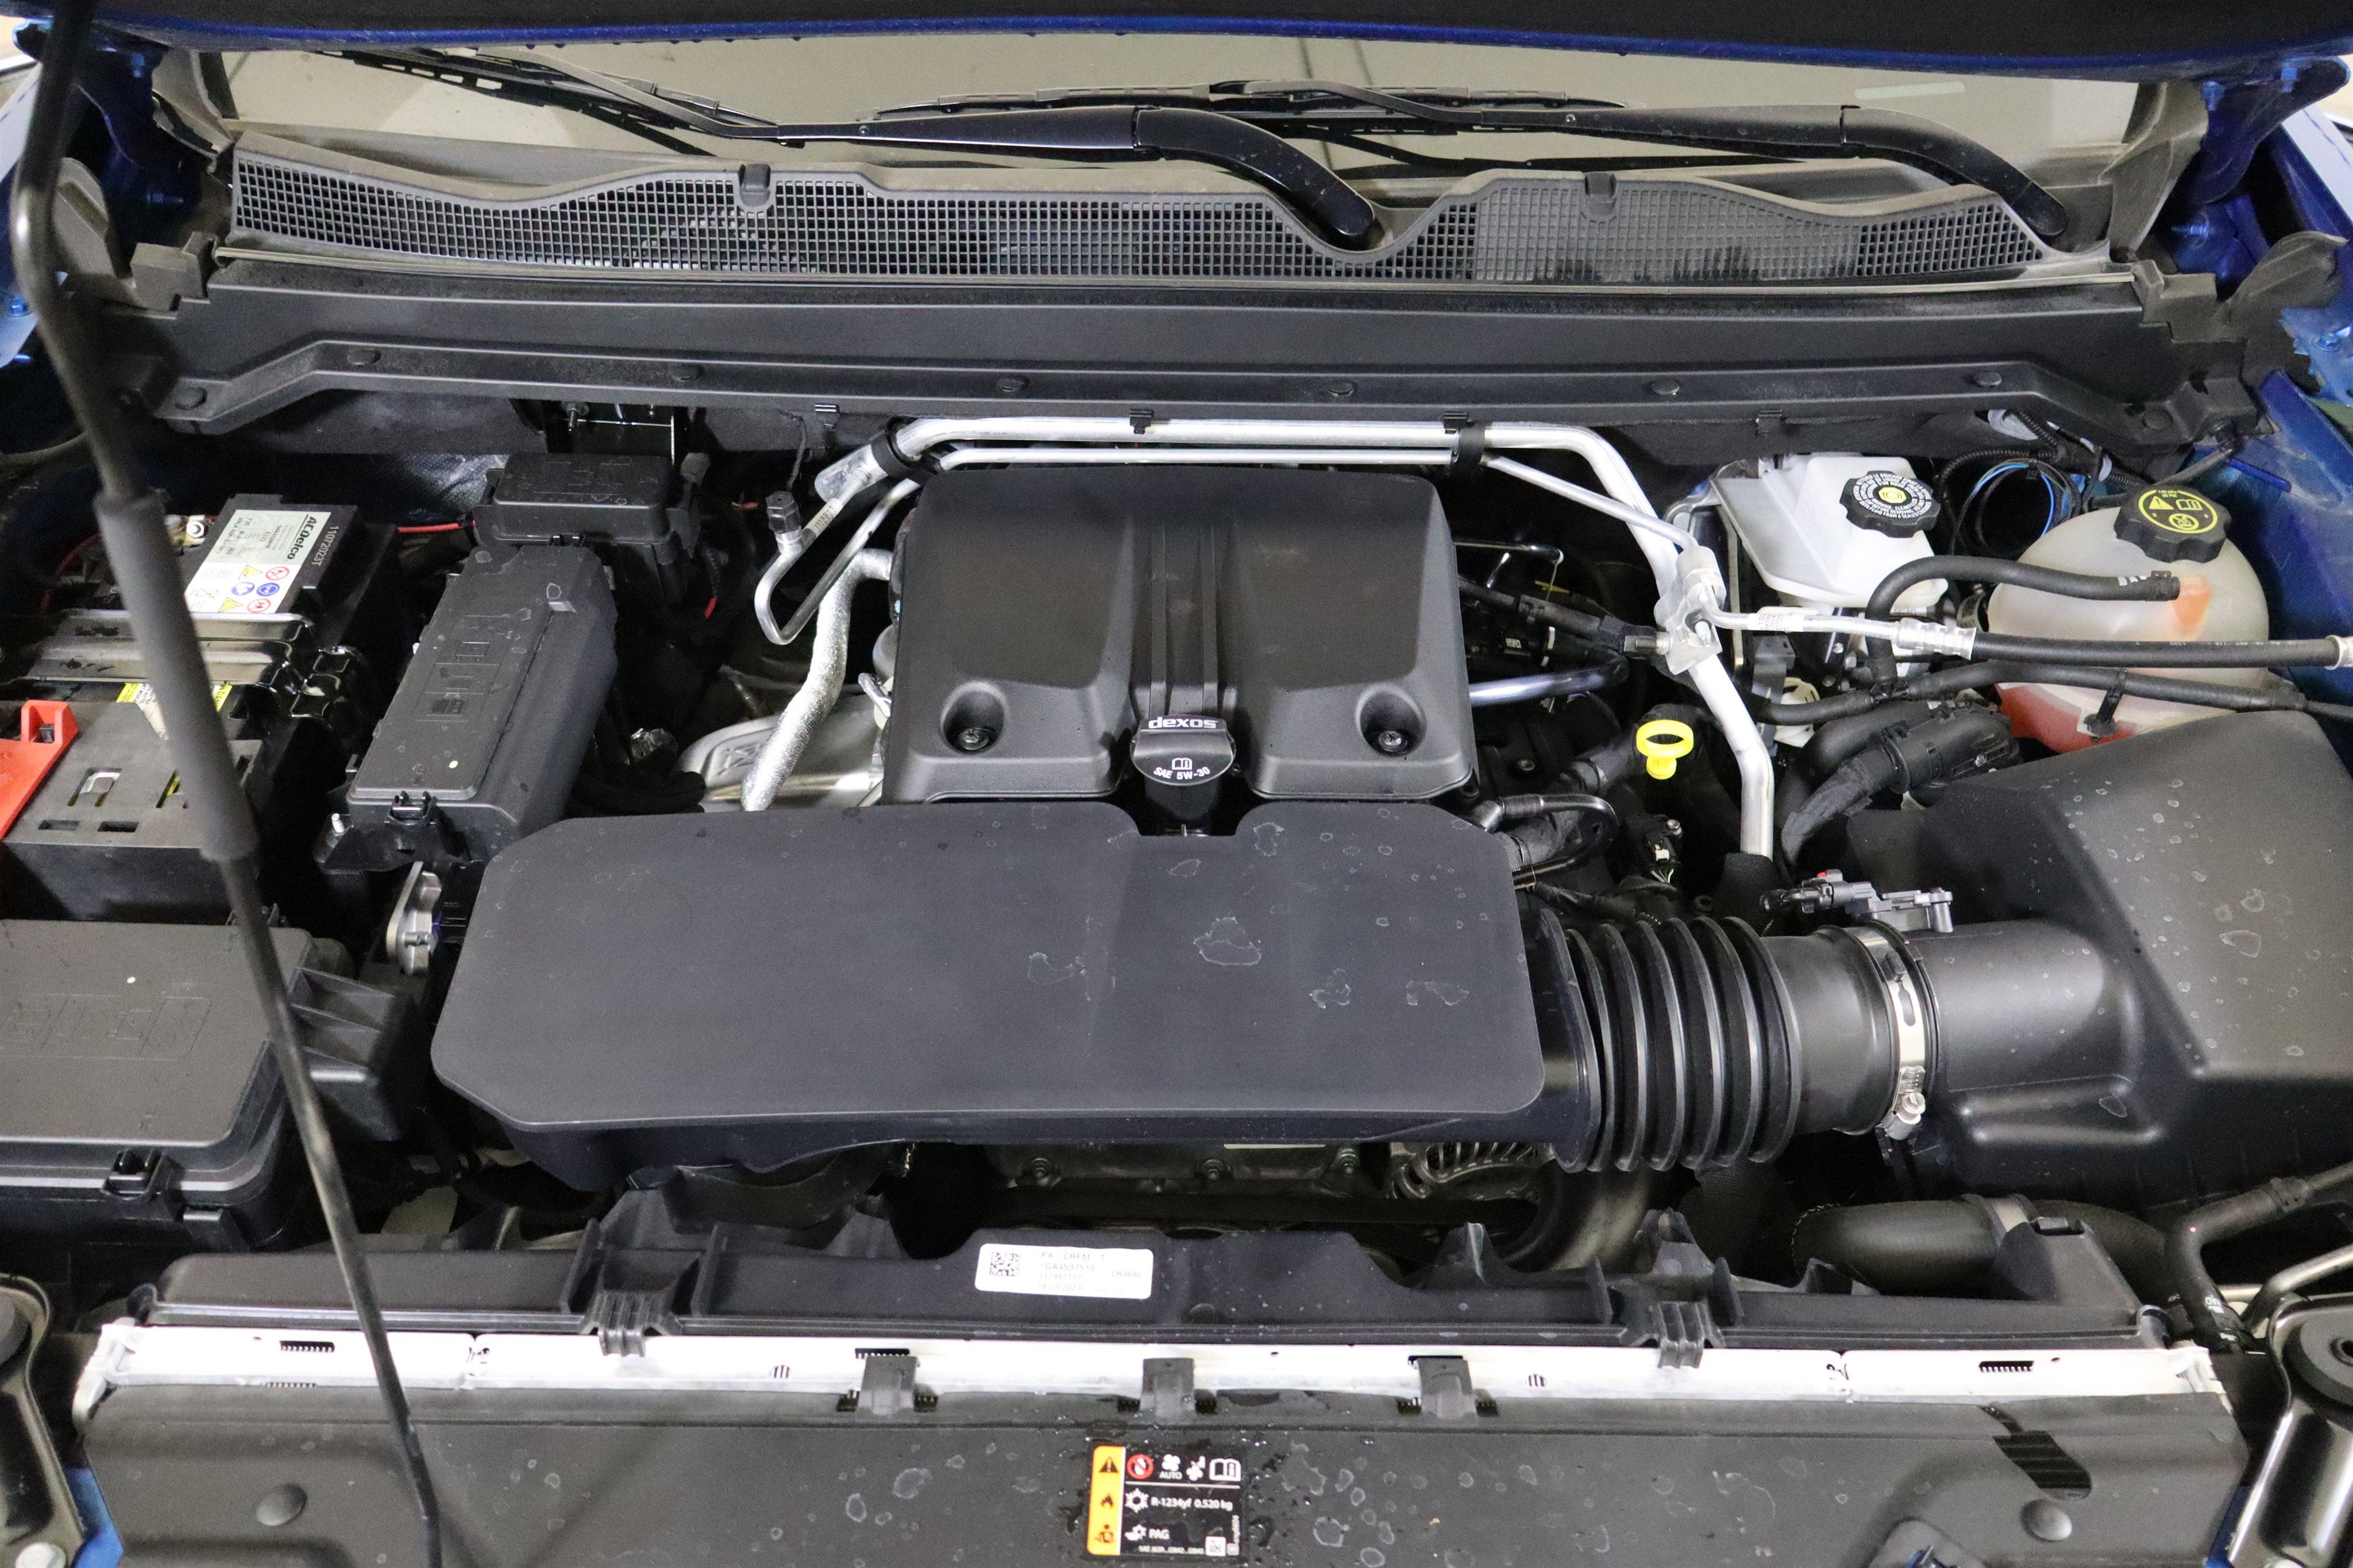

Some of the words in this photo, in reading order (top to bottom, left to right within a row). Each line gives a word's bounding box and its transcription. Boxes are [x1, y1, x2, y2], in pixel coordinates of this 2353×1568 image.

[287, 516, 318, 560] ACDelco
[311, 526, 340, 566] 11072023T
[1149, 717, 1217, 728] dexos
[1154, 767, 1173, 779] SAE
[1176, 766, 1210, 779] 5W-30
[1159, 1471, 1182, 1480] AUTO
[1151, 1497, 1193, 1509] R-1234yf
[1194, 1499, 1220, 1509] 0.520
[1220, 1499, 1233, 1512] kg
[1148, 1529, 1170, 1540] PAG
